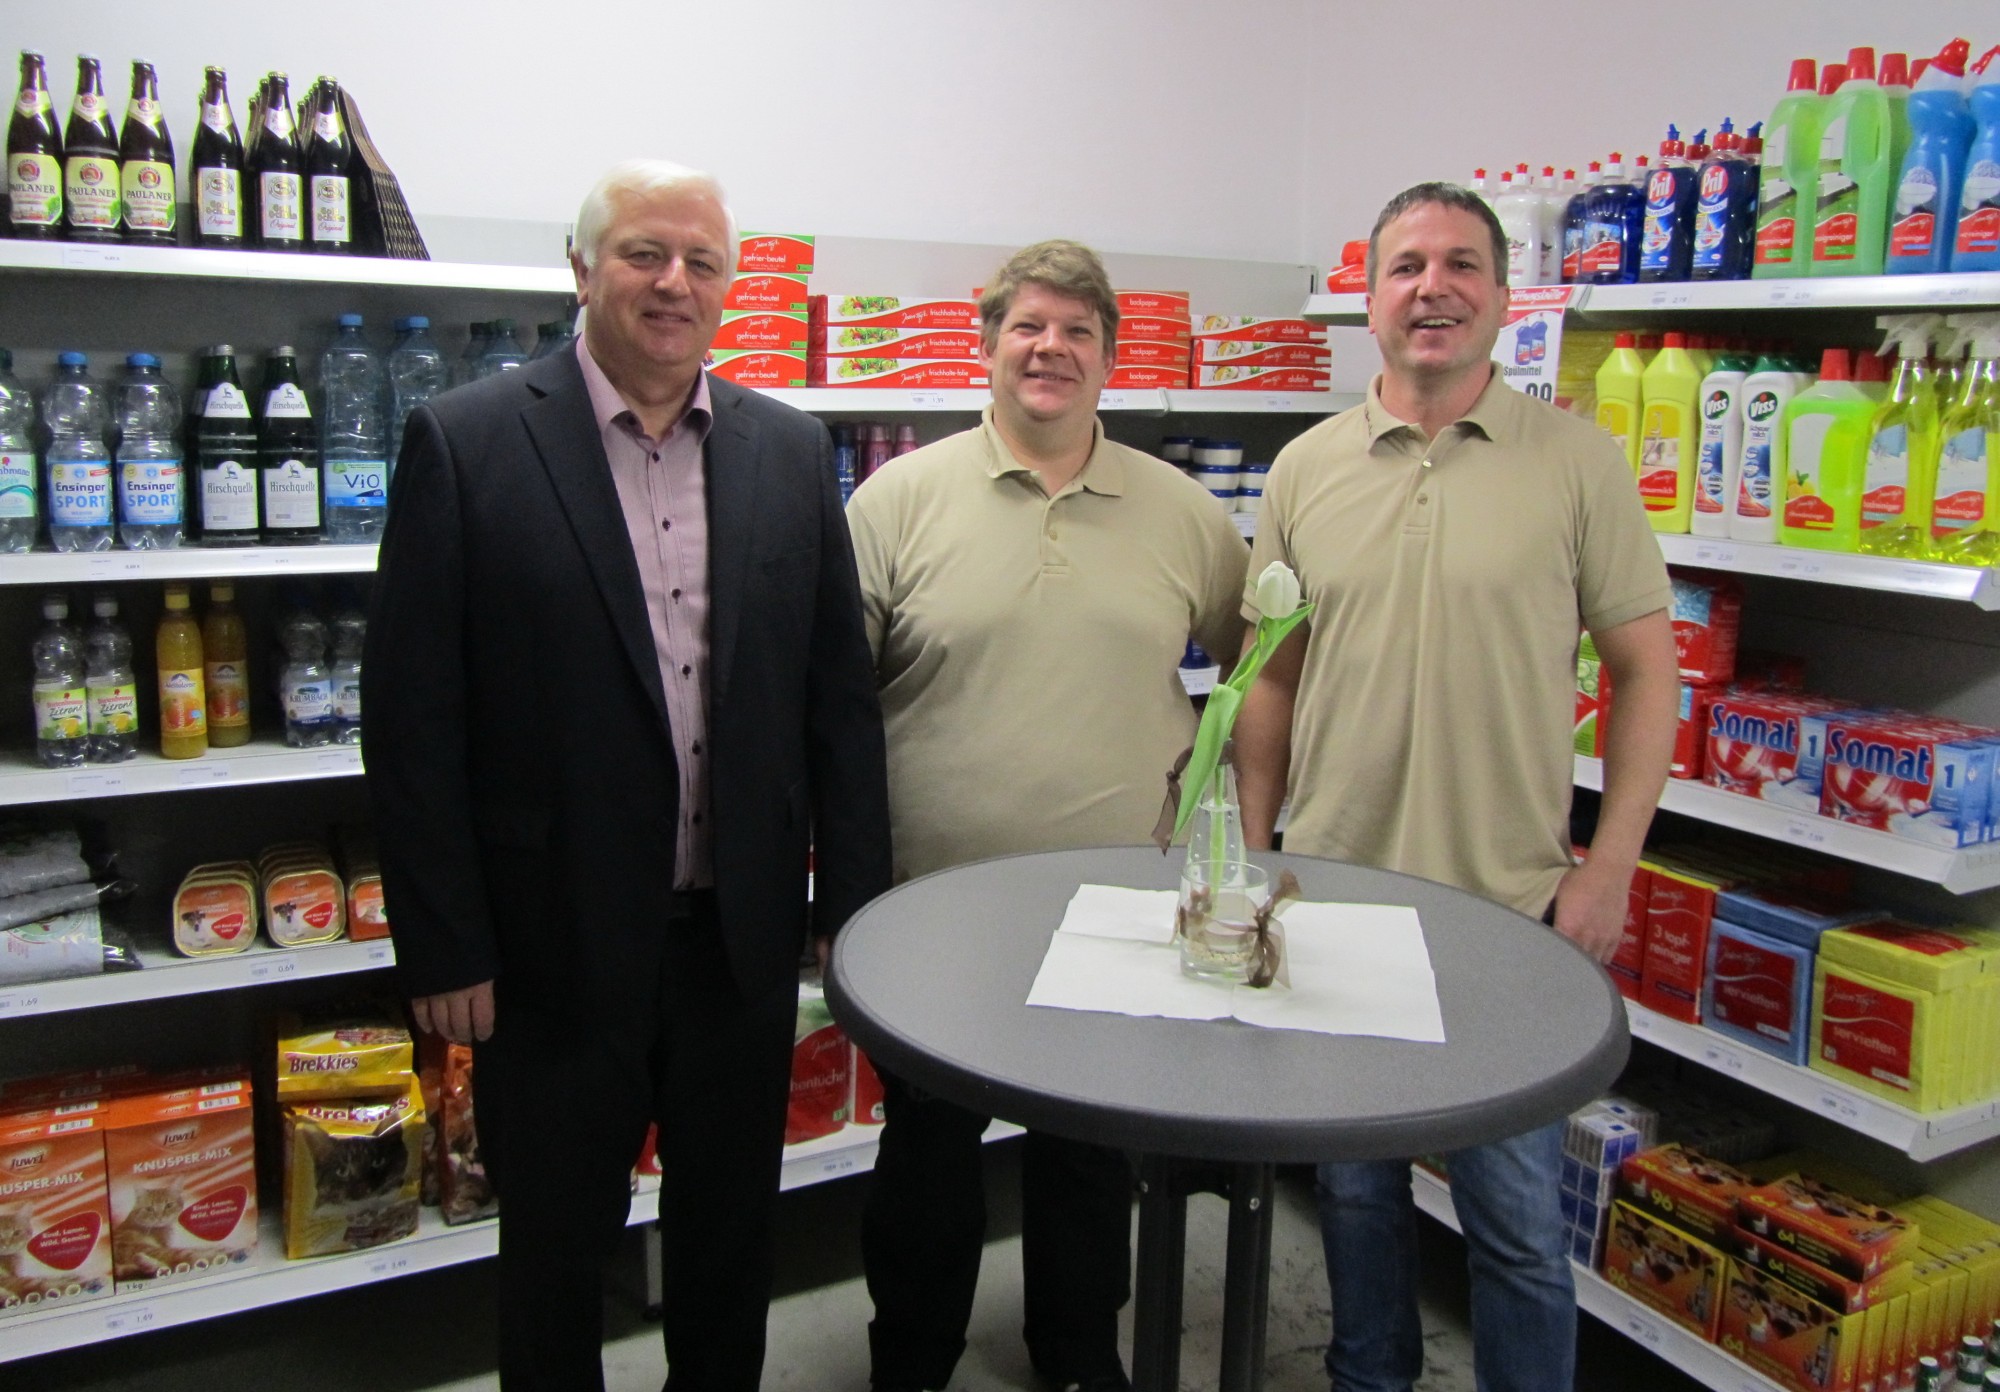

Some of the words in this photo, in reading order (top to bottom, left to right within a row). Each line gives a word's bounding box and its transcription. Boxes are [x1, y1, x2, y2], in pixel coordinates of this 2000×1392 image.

[1649, 177, 1671, 200] Pril
[1702, 172, 1724, 195] Pril
[68, 188, 117, 198] PAULANER
[126, 190, 172, 200] PAULANER
[743, 254, 787, 264] gefrier-beutel
[736, 293, 780, 303] gefrier-beutel
[1129, 299, 1159, 308] backpapier
[930, 308, 970, 317] frischhalte-folie
[1132, 322, 1161, 331] backpapier
[736, 332, 780, 342] gefrier-beutel
[929, 339, 969, 347] frischhalte-folie
[1129, 348, 1159, 357] backpapier
[735, 370, 779, 380] gefrier-beutel
[928, 369, 969, 377] frischhalte-folie
[1129, 373, 1158, 381] backpapier
[1504, 366, 1542, 376] Spülmittel
[1706, 399, 1728, 416] Viss
[1750, 400, 1776, 417] Viss
[55, 482, 106, 494] Ensinger
[127, 481, 175, 492] Ensinger
[207, 482, 254, 495] Hirschquelle
[270, 481, 316, 494] Hirschquelle
[56, 495, 106, 508] SPORT
[128, 494, 177, 507] SPORT
[1710, 703, 1798, 754] Somat
[1808, 734, 1817, 758] 1
[1827, 729, 1931, 785] Somat
[1943, 764, 1955, 788] 1
[1654, 925, 1662, 938] 3
[1664, 929, 1690, 948] topf-
[1650, 942, 1693, 965] reiniger
[1723, 985, 1780, 1010] servietten
[1833, 1026, 1897, 1056] servietten
[290, 1054, 359, 1073] Brekkies
[133, 1147, 233, 1174] KNUSPER-MIX
[0, 1171, 84, 1196] USPER-MIX
